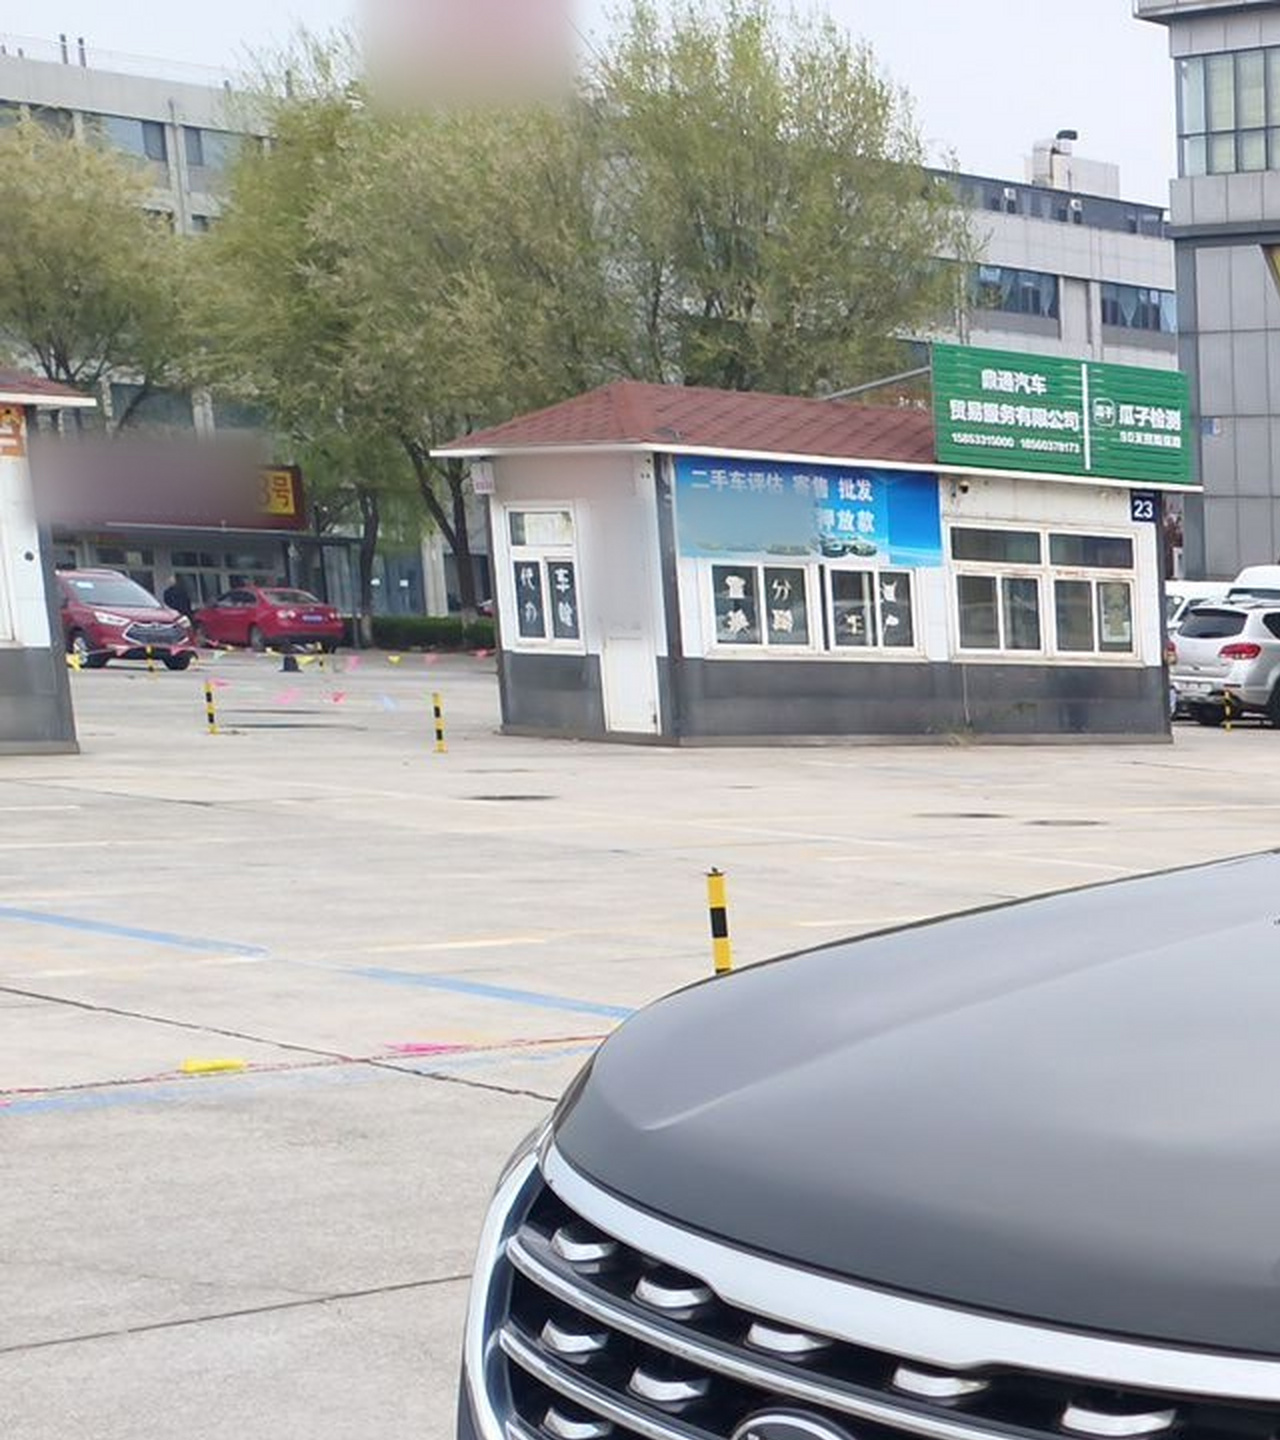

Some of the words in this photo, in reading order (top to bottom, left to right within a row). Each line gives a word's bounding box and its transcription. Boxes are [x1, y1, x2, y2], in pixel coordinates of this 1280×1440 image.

[1118, 404, 1182, 431] 瓜子检测
[691, 469, 784, 495] 二手车评估
[838, 477, 874, 502] 批发
[1133, 500, 1153, 518] 23
